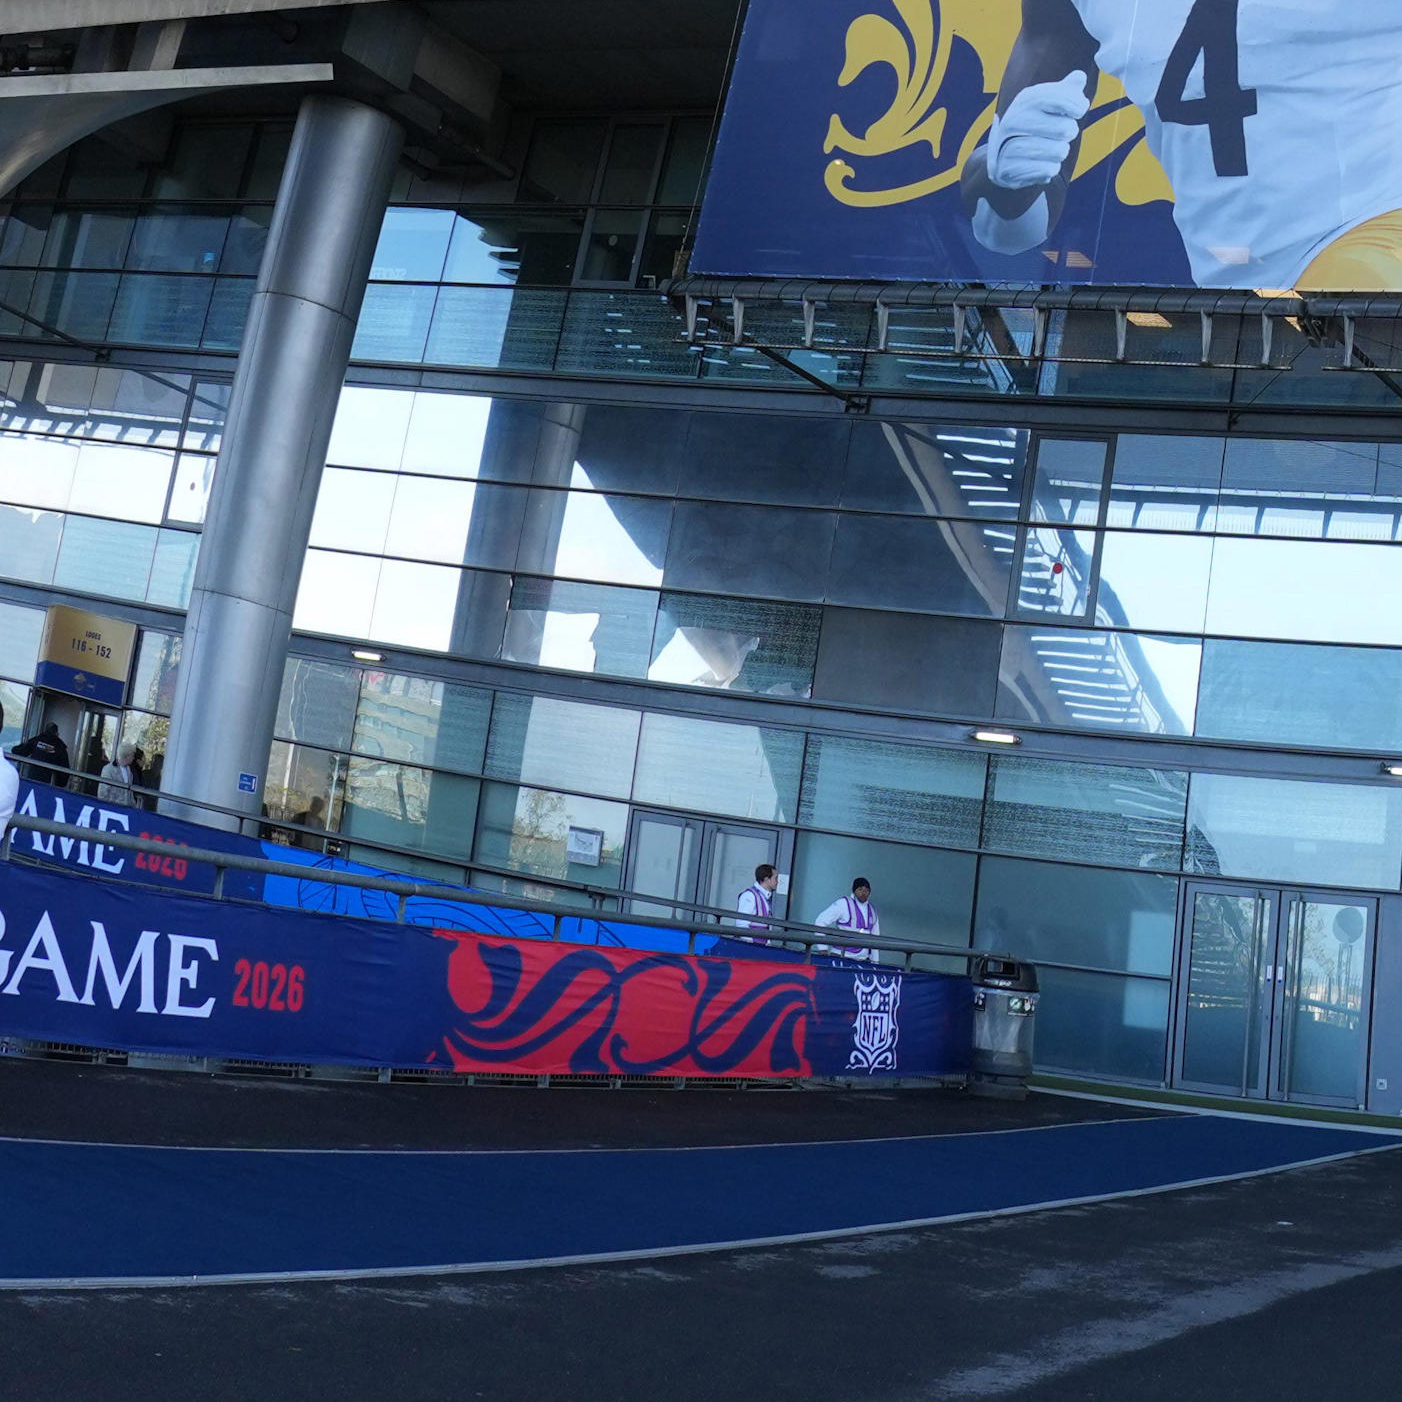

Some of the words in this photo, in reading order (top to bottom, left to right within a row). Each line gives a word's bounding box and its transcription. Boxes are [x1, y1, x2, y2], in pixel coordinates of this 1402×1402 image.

[72, 638, 87, 652] 116
[96, 645, 111, 659] 152
[11, 788, 130, 875] AME
[0, 909, 219, 1018] AME
[232, 958, 305, 1012] 2026
[863, 1015, 887, 1048] NFL
